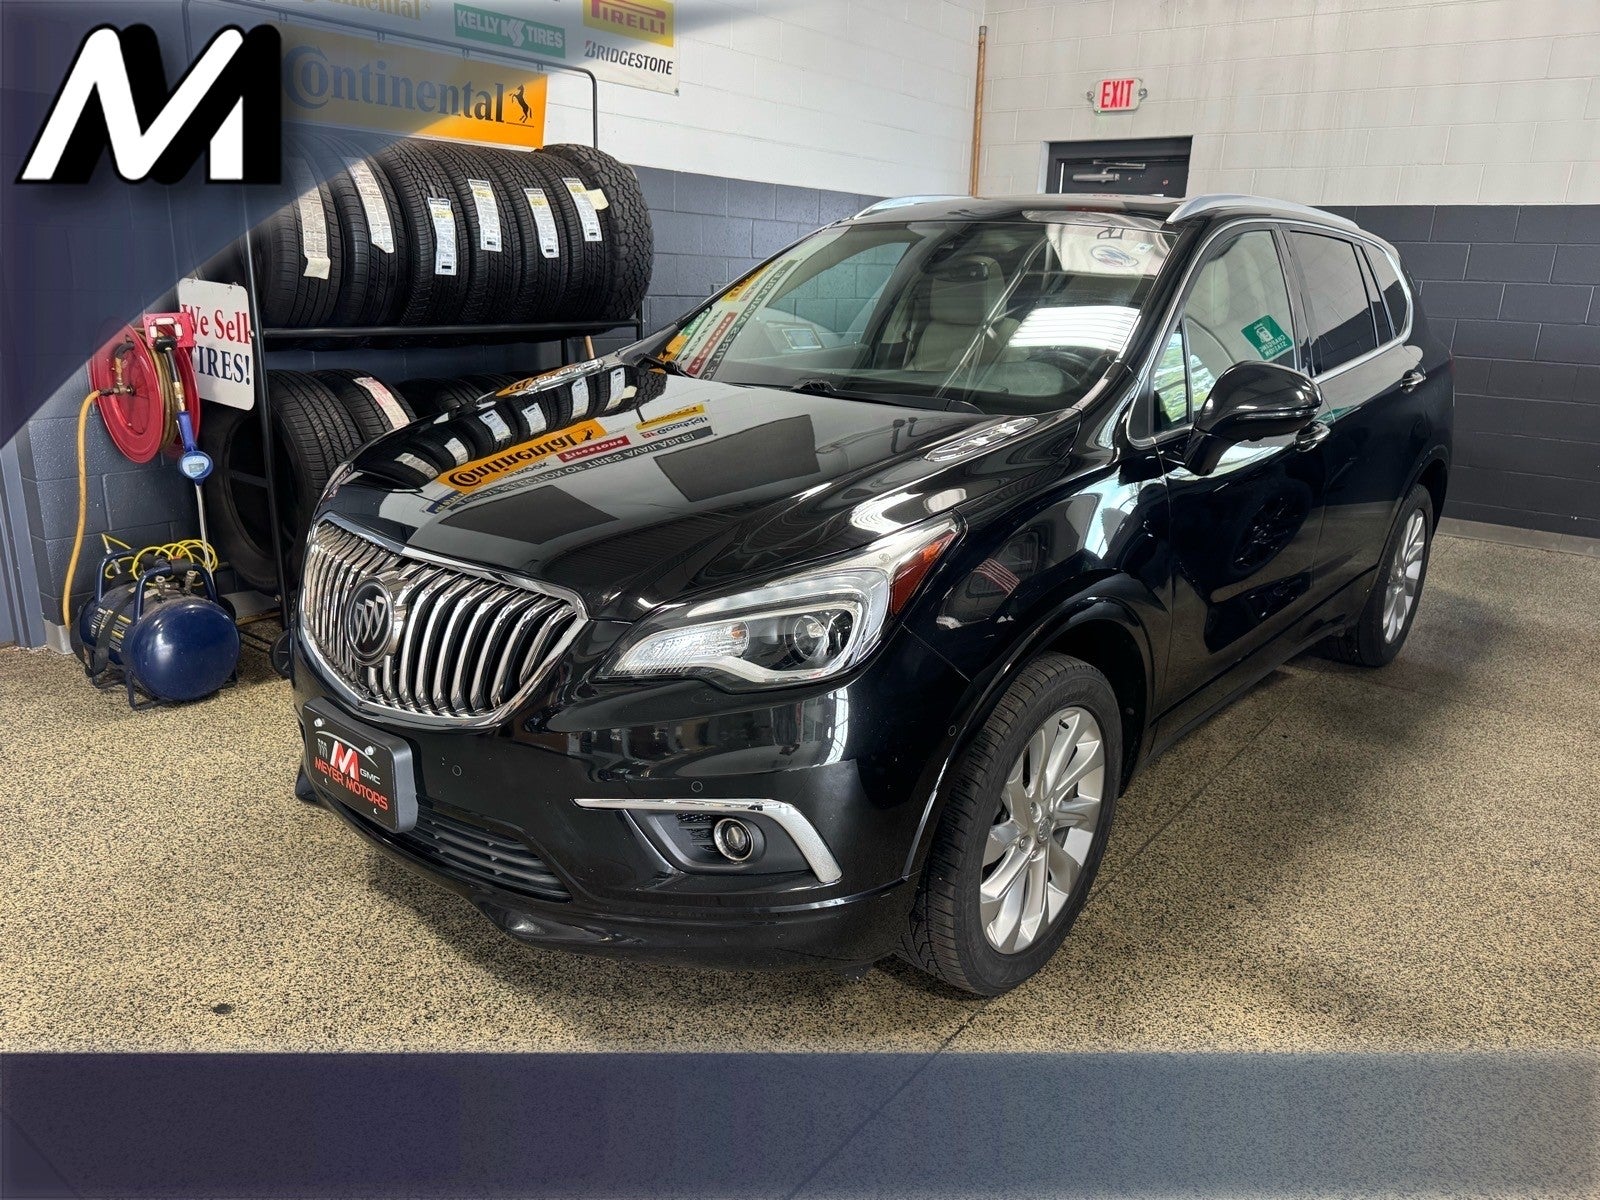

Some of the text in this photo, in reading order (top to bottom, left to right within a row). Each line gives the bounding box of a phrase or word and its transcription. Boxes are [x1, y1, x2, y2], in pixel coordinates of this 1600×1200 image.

[457, 10, 499, 35] KELLY
[527, 27, 563, 49] TIRES
[591, 0, 666, 35] PIRELLI
[584, 40, 673, 75] BRIDGESTONE
[282, 45, 504, 123] Continental
[1100, 80, 1134, 108] EXIT
[181, 304, 250, 344] We Sell
[193, 341, 250, 385] IRES!
[314, 756, 388, 811] MEYER MOTORS
[360, 768, 381, 785] GMC
